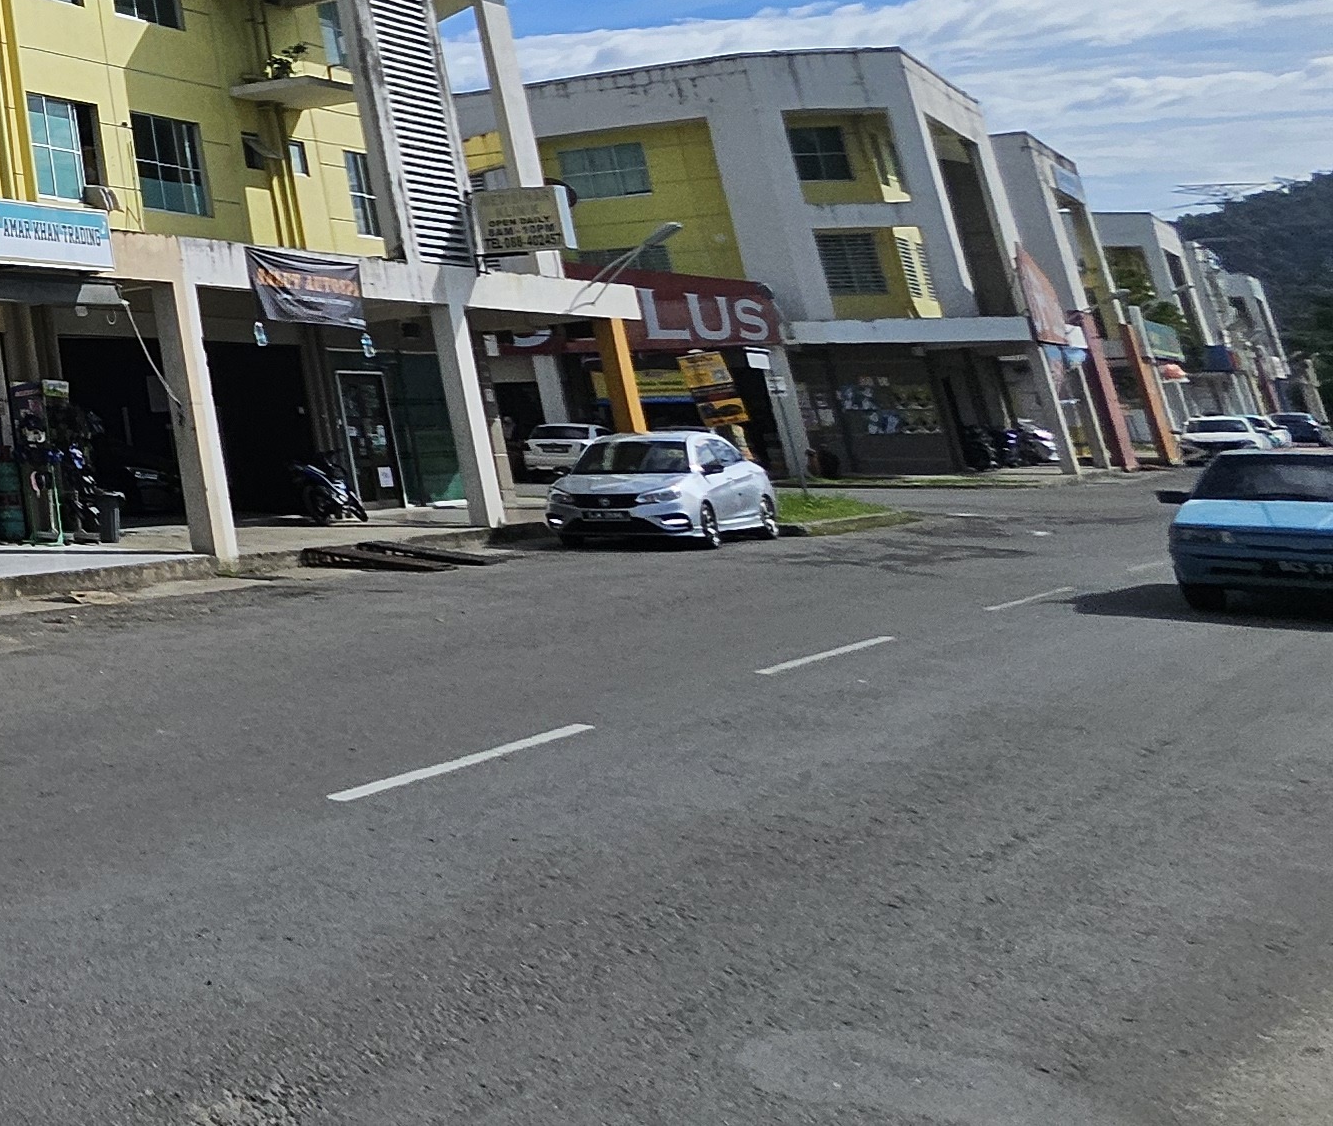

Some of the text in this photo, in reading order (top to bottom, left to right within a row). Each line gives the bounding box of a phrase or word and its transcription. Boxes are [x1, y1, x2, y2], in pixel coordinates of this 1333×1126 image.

[488, 214, 551, 228] OPEN DAILY
[3, 218, 102, 247] AMAR KHAN TRADING
